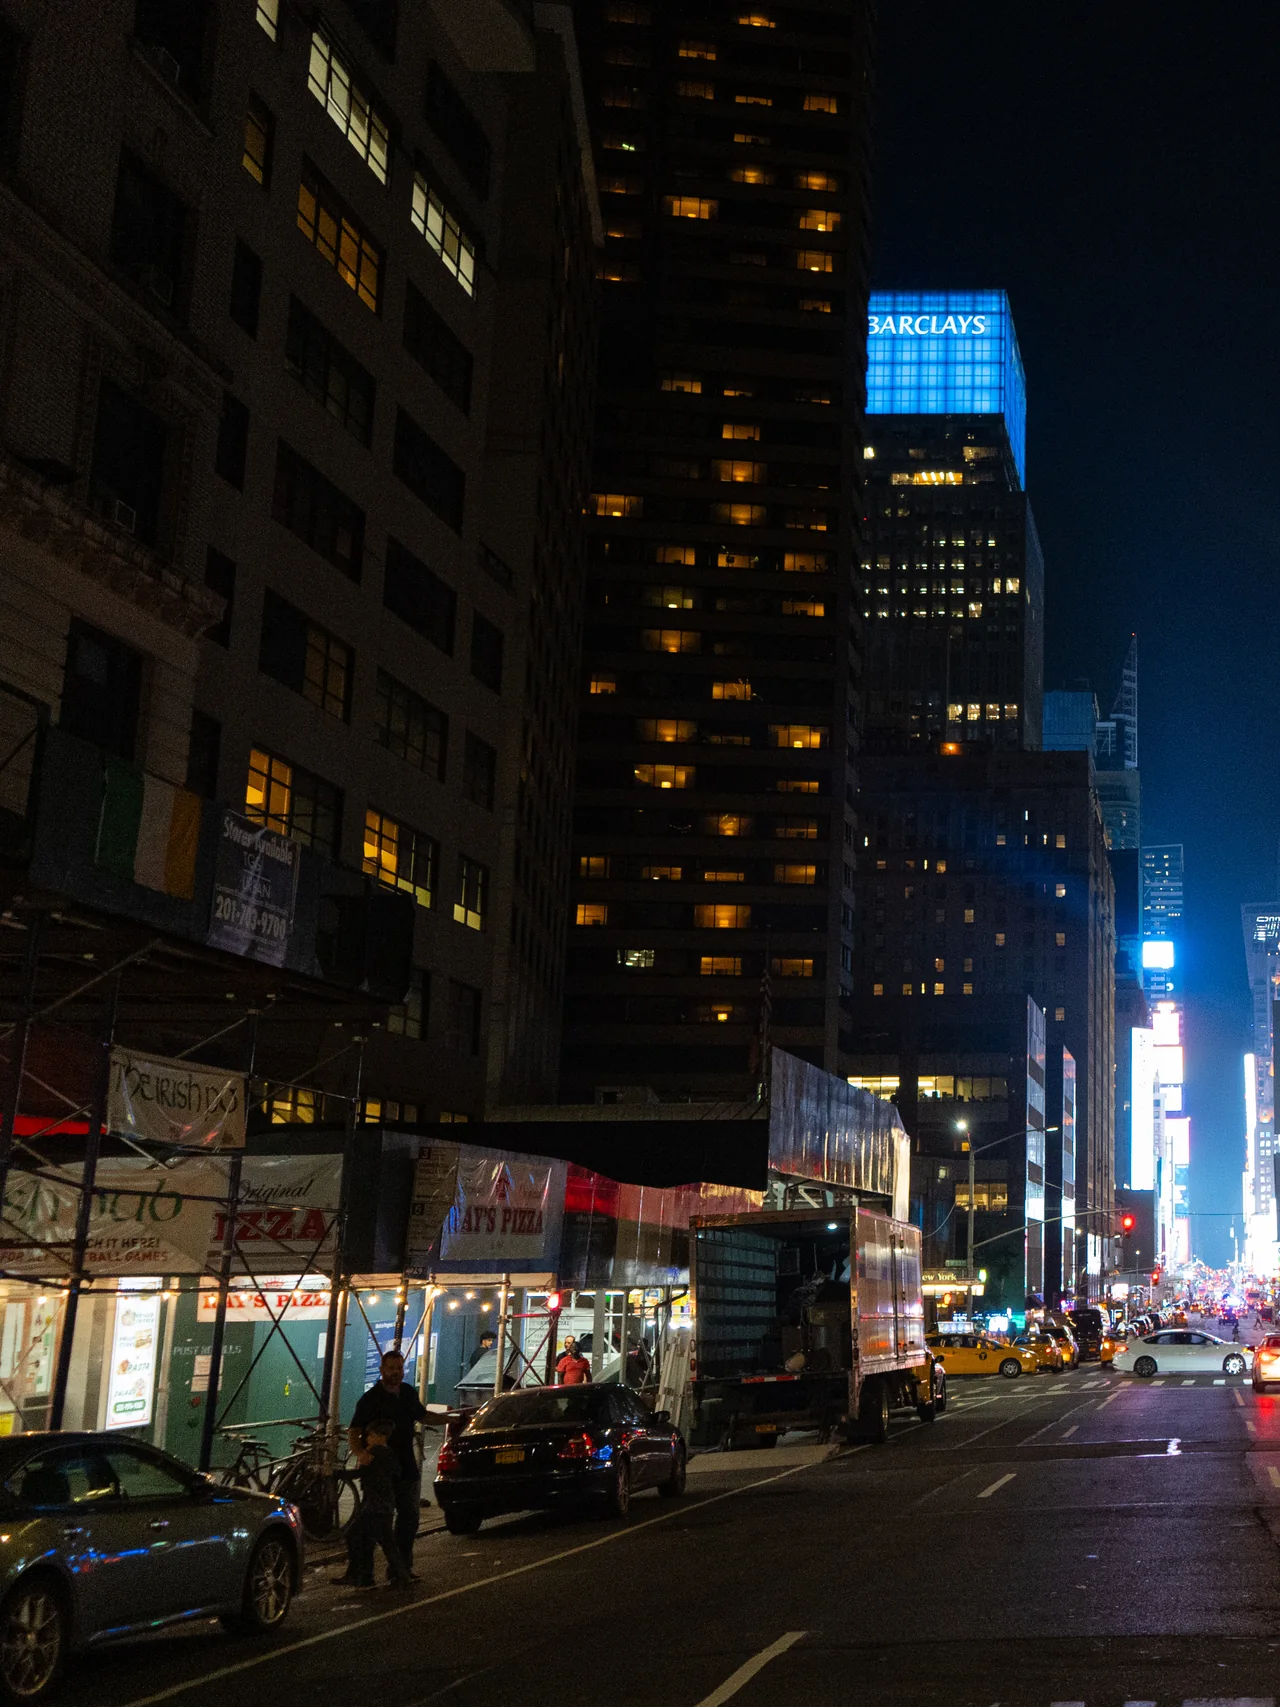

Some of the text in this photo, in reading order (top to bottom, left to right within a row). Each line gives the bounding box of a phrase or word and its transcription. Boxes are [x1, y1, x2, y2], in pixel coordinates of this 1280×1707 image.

[868, 315, 986, 335] BARCLAYS
[237, 1178, 314, 1203] Original
[501, 1206, 543, 1235] PIZZA
[922, 1272, 957, 1281] ew York
[276, 1293, 330, 1308] PIZZ
